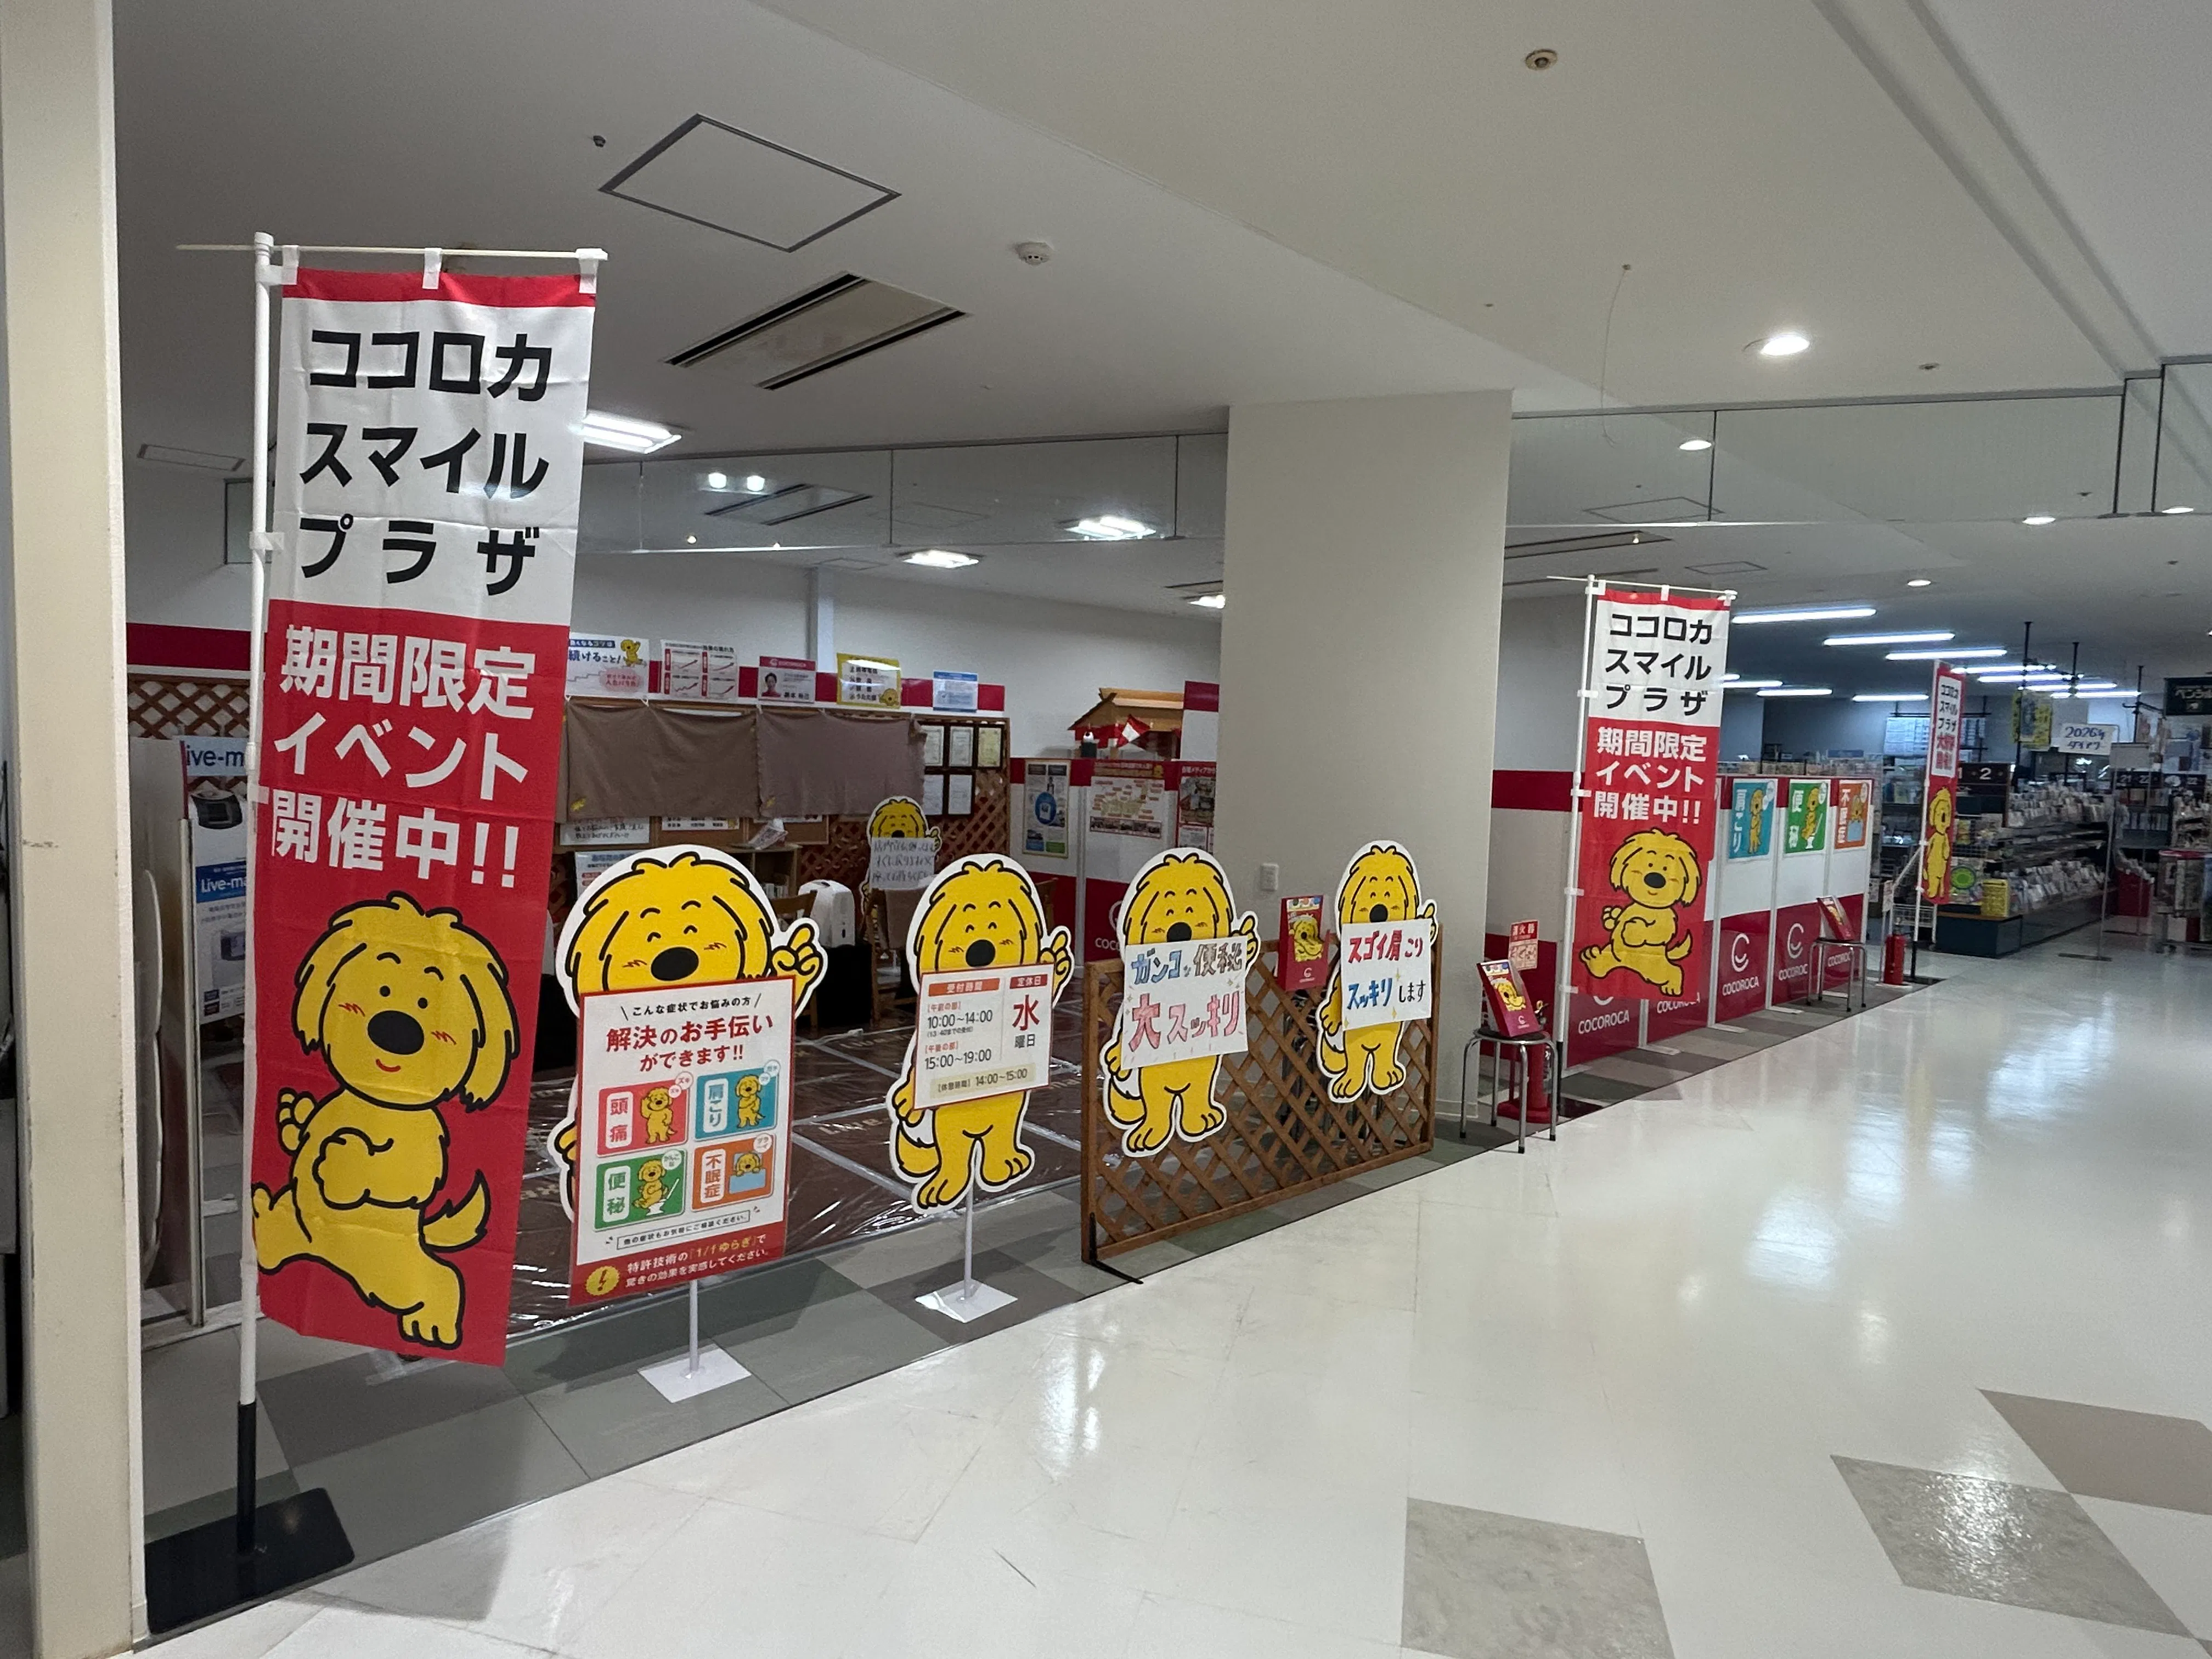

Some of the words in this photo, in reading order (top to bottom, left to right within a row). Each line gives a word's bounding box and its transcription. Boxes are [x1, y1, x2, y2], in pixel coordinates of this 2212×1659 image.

[310, 330, 552, 402] ココロカ
[299, 422, 550, 499] スマイル
[300, 513, 540, 596] プラザ
[1610, 613, 1712, 645] ココロカ
[279, 624, 538, 720] 期間限定
[1605, 648, 1712, 681] スマイル
[1606, 684, 1709, 716] プラザ
[187, 744, 245, 768] ive-m
[274, 712, 528, 801] イベント
[1597, 726, 1707, 762] 期間限定
[1595, 761, 1704, 793] イベント
[1979, 768, 1991, 780] 2
[1593, 790, 1701, 824] 開催中!!
[271, 788, 520, 888] 開催中!!
[1779, 963, 1808, 981] COCOROC
[1827, 951, 1852, 967] COCOROC
[946, 980, 983, 994] 受付時間
[1017, 976, 1042, 987] 定休日
[1722, 976, 1759, 996] COCOROCA
[632, 996, 751, 1017] こんな症状でお悩みの方
[1012, 994, 1040, 1031] 水
[1128, 990, 1241, 1052] 大スッキリ
[1578, 1009, 1630, 1035] COCOROCA
[606, 1015, 774, 1053] 解決のお手伝い
[1014, 1034, 1036, 1049] 曜日
[640, 1045, 744, 1073] ができます!!
[610, 1097, 629, 1143] 頭痛
[703, 1154, 723, 1198] 不眠症
[607, 1172, 626, 1216] 便秘
